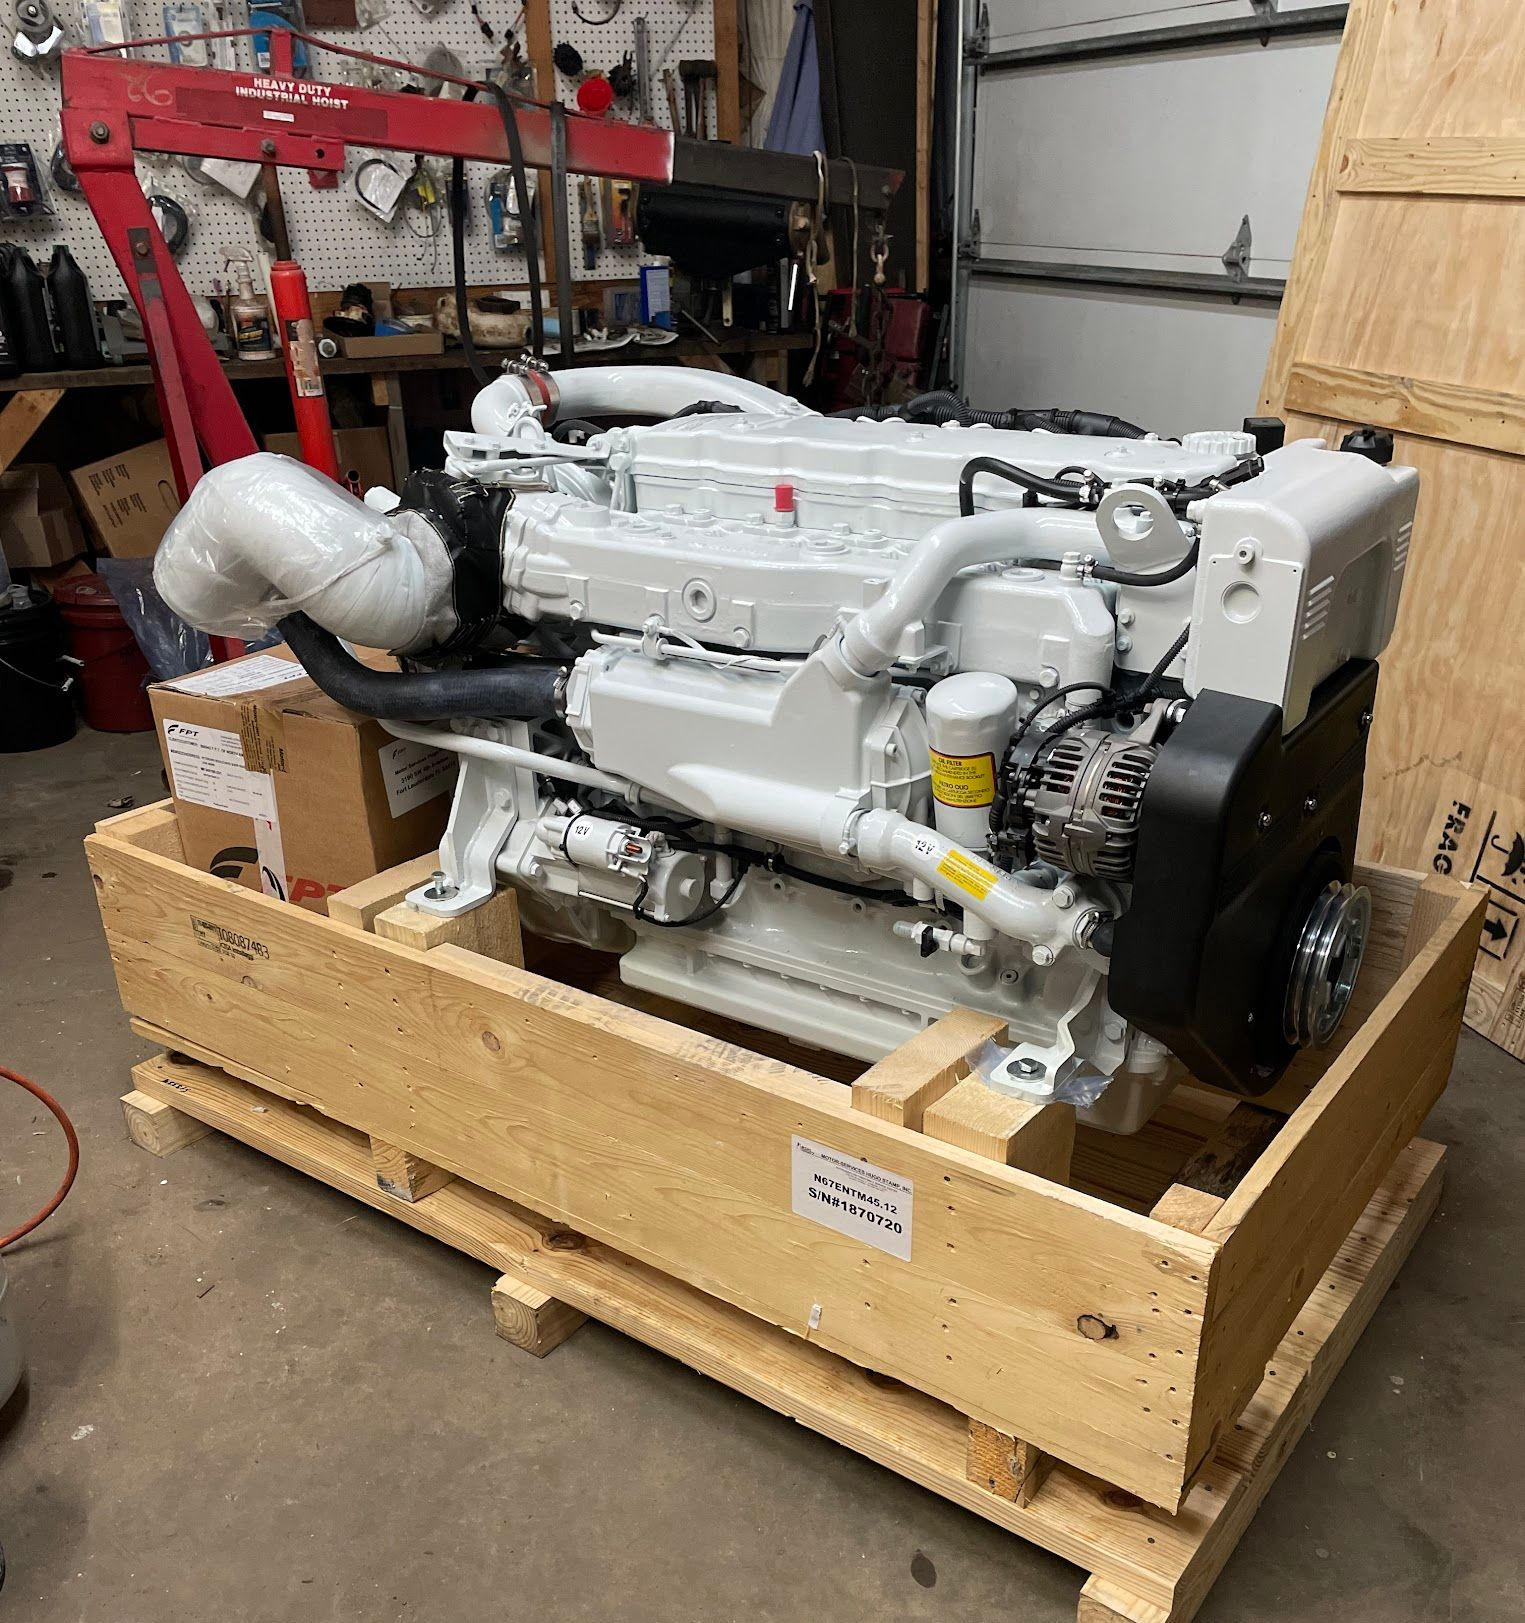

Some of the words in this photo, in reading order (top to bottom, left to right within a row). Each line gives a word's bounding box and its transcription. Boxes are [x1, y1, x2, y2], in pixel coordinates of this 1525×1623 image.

[235, 86, 309, 105] INDUSTRIAL
[312, 96, 349, 110] HOIST
[254, 78, 295, 92] HEAVY
[298, 83, 332, 97] DUTY
[179, 728, 199, 737] FPT
[1433, 800, 1471, 875] FRAG
[808, 1186, 903, 1234] S/N#1870720
[814, 1173, 898, 1215] N67ENTM45.12
